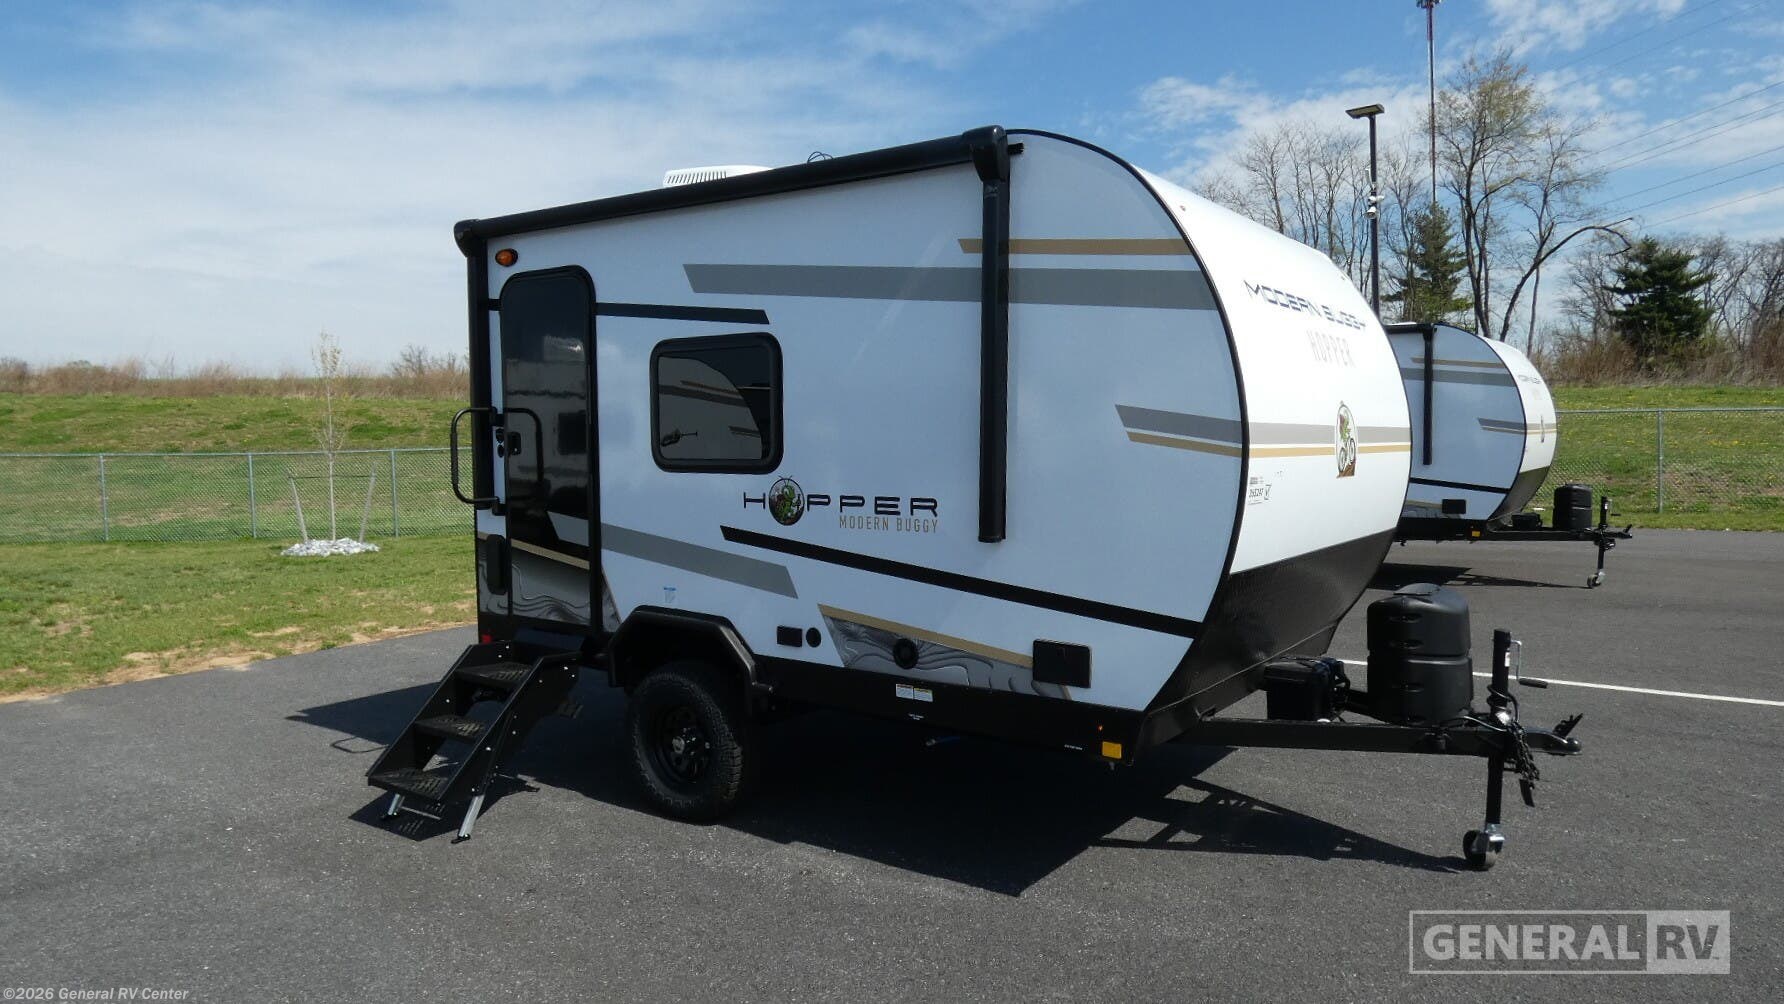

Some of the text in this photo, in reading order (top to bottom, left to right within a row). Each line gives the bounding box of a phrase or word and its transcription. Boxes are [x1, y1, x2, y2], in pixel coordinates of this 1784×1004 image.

[1243, 279, 1322, 317] MODERN
[1306, 328, 1357, 368] HOPPER
[839, 516, 938, 534] MODERN BUGGY
